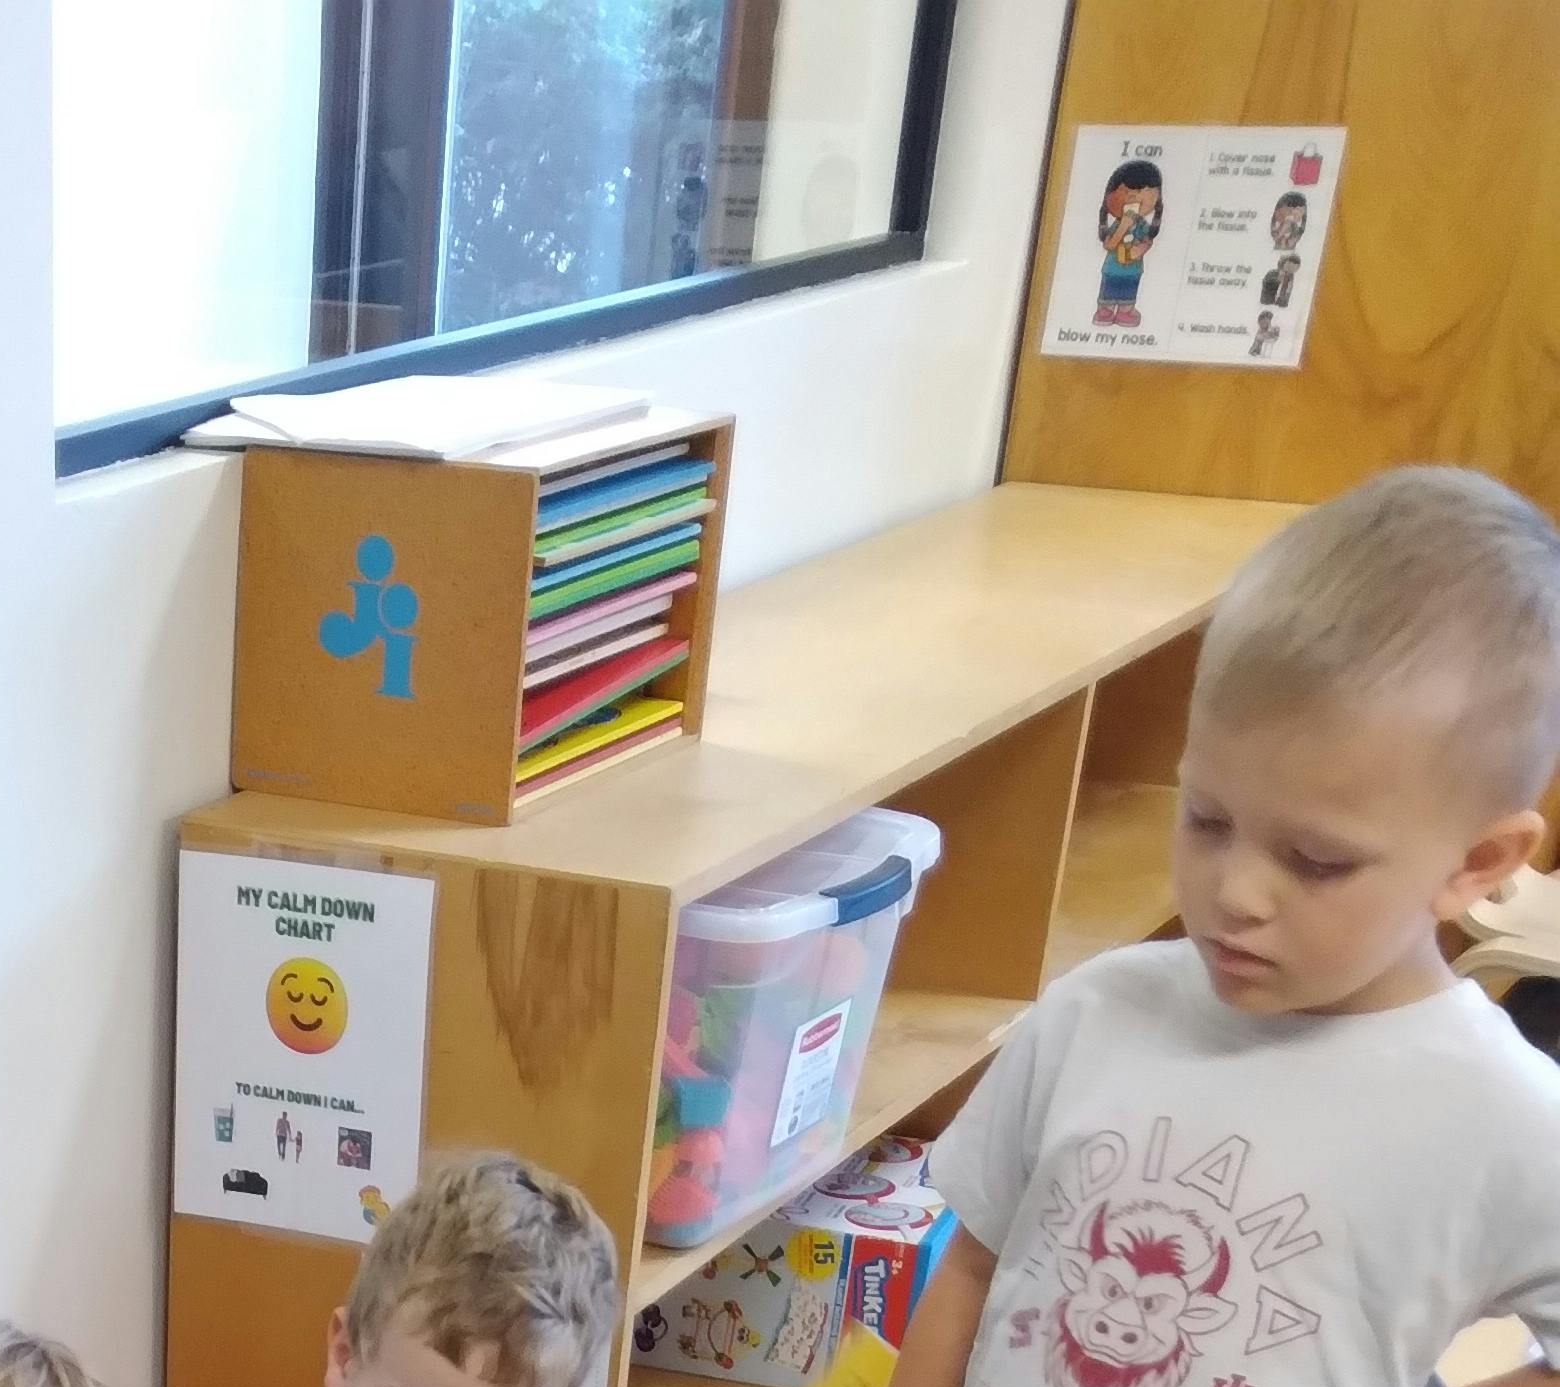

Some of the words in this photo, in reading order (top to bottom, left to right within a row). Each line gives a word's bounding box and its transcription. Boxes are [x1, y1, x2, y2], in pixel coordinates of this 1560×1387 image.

[1121, 141, 1130, 157] I
[1135, 145, 1163, 157] can
[1058, 329, 1090, 343] blow
[1094, 334, 1117, 348] my
[1121, 334, 1158, 346] nose.
[237, 886, 262, 909] MY
[267, 890, 316, 915] CALM
[321, 897, 375, 922] DOWN
[275, 916, 336, 942] CHART
[236, 1082, 251, 1097] TO
[253, 1085, 284, 1101] CALM
[287, 1089, 321, 1107] DOWN
[813, 1241, 835, 1264] 15
